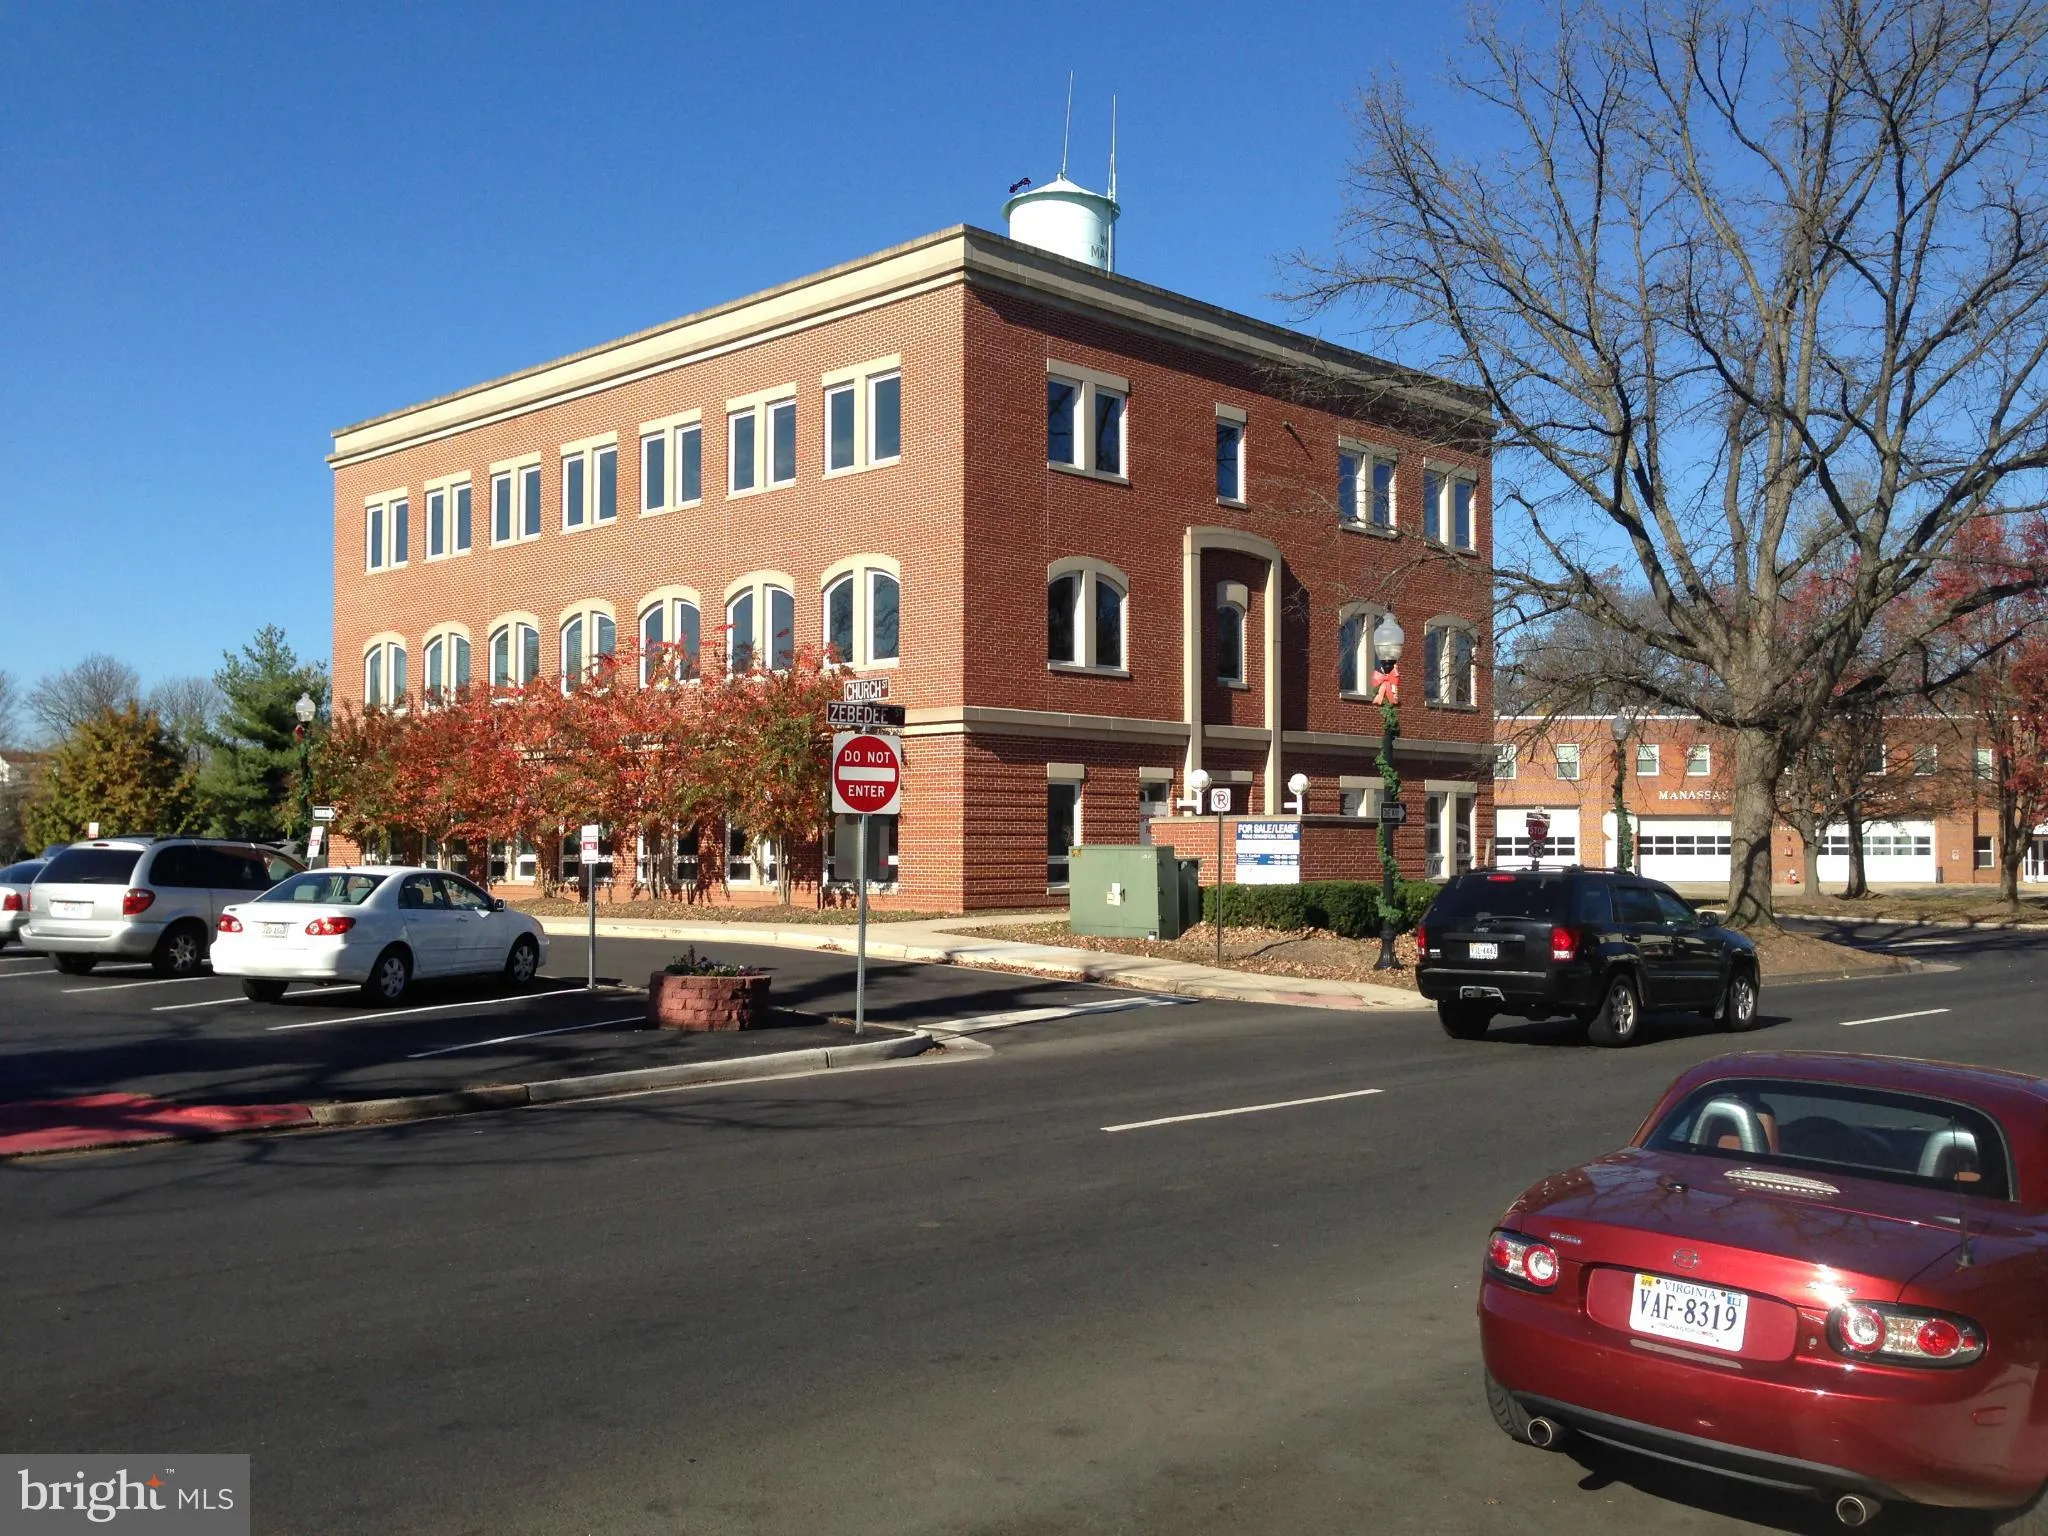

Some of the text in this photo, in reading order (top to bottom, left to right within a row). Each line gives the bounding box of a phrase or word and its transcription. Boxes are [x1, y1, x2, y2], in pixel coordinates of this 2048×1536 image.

[846, 681, 881, 701] CHURCH
[829, 704, 889, 724] ZEBEDEE
[844, 750, 890, 764] DO NOT
[848, 785, 885, 798] ENTER
[1659, 790, 1729, 800] MANASSAS
[1238, 824, 1299, 834] FOR SALE/LEASE
[1530, 826, 1547, 835] STOP
[1664, 1281, 1717, 1300] VIRGINIA
[1640, 1288, 1737, 1331] VAF-8319
